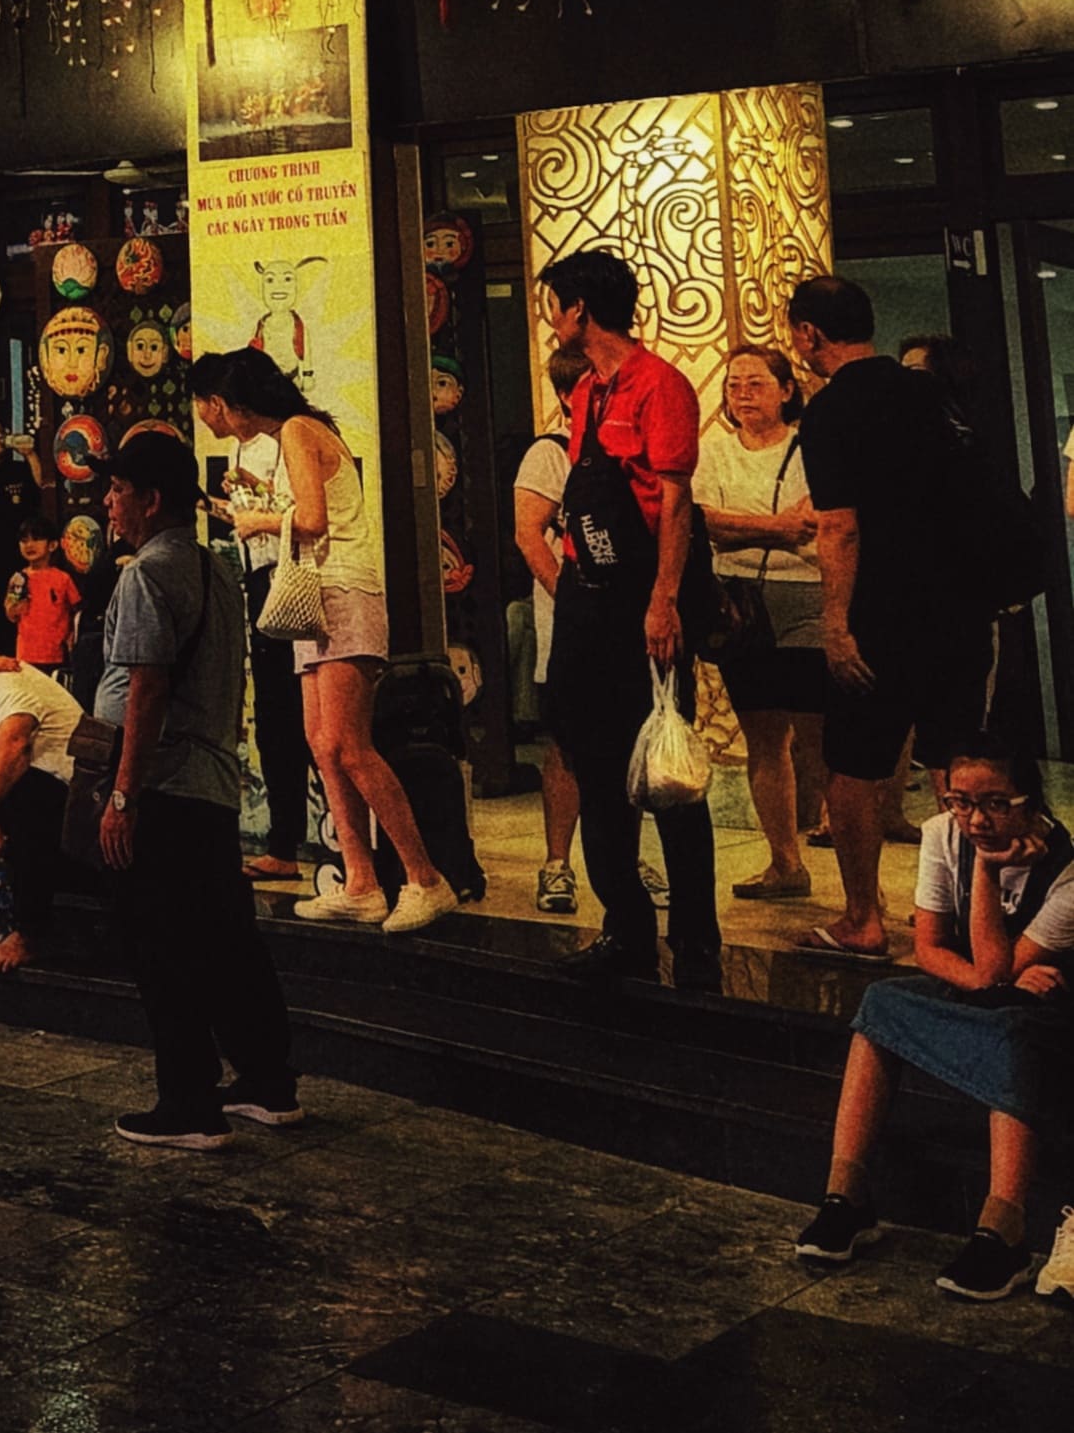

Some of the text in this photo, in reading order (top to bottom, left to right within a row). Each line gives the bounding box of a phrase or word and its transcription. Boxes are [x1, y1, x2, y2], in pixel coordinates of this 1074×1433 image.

[233, 215, 265, 234] NGÀY
[268, 213, 310, 232] TRONG
[580, 513, 607, 565] NORTH
[596, 528, 619, 565] FACE
